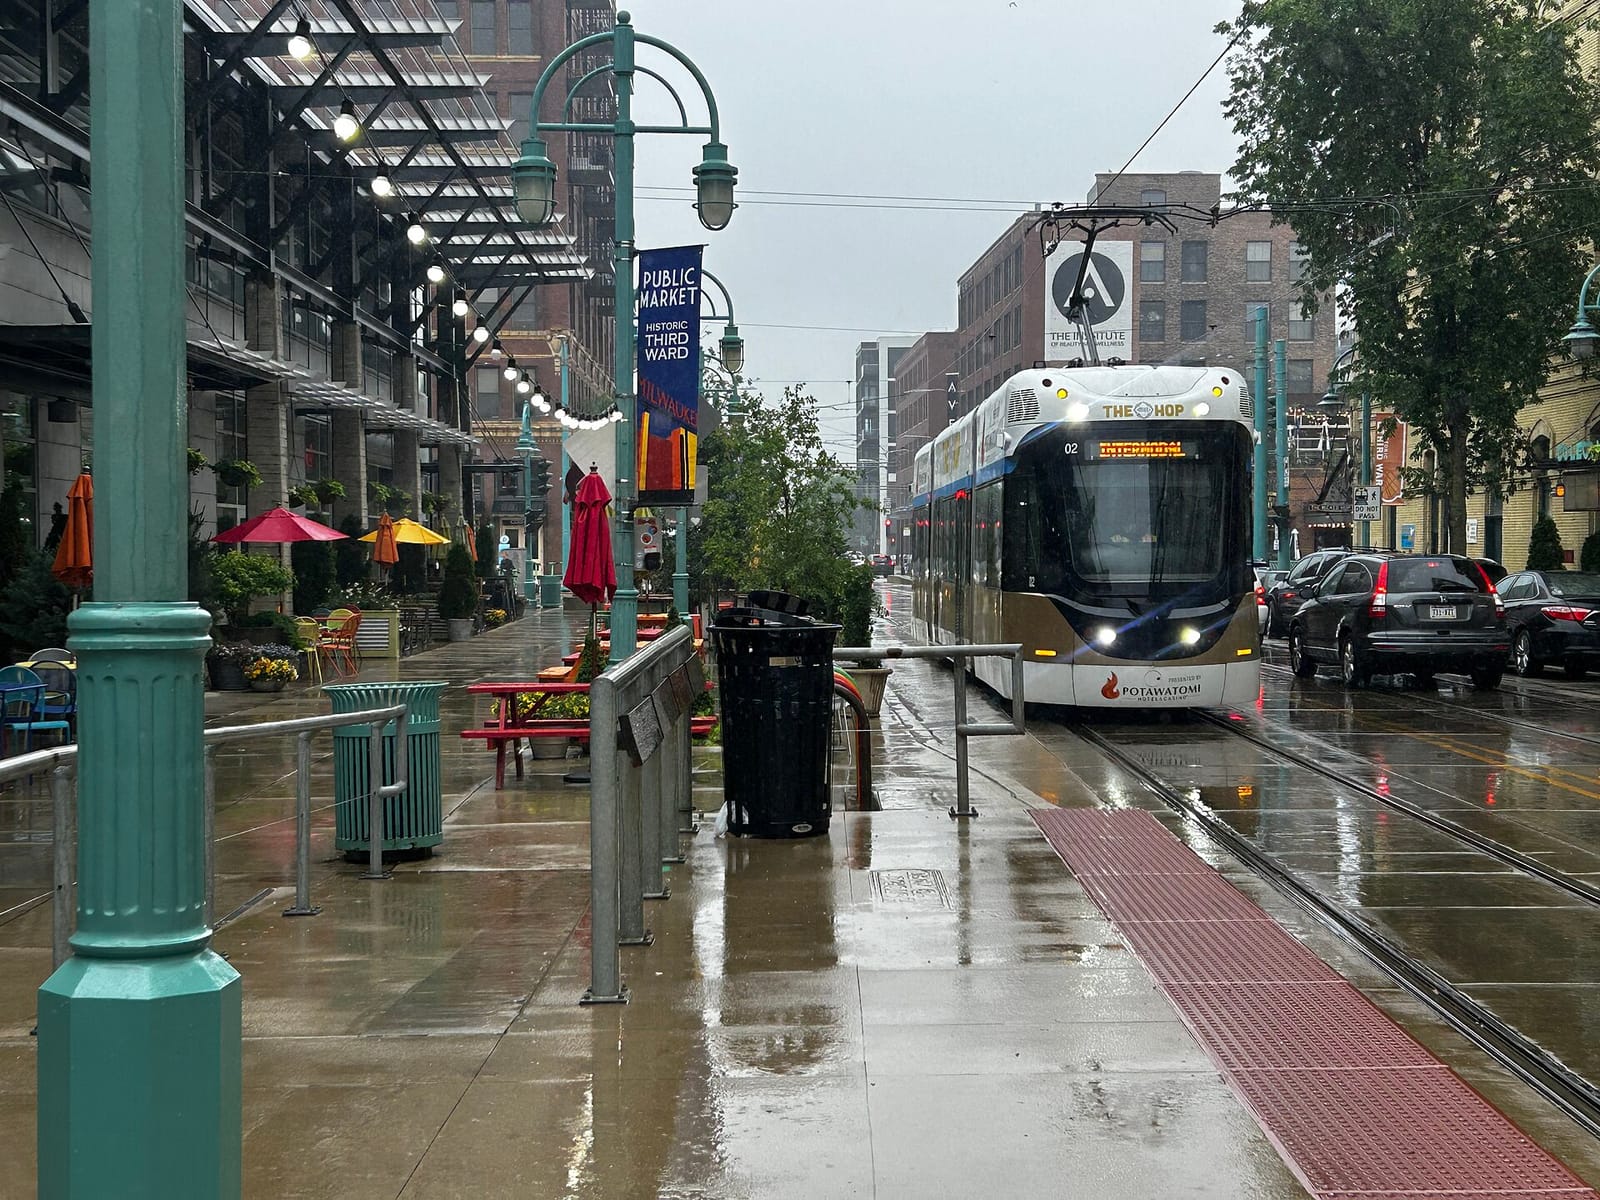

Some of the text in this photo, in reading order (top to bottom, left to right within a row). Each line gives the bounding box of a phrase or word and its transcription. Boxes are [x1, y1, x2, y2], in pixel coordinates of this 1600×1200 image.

[643, 267, 696, 289] PUBLIC
[640, 286, 699, 309] MARKET
[646, 320, 688, 332] HISTORIC
[645, 332, 689, 347] THIRD
[1051, 332, 1071, 341] THE
[645, 346, 689, 361] WARD
[1102, 404, 1134, 418] THE
[1154, 403, 1185, 417] HOP
[1064, 442, 1079, 454] 02
[1375, 463, 1385, 487] WAR
[1355, 505, 1365, 513] DO
[1122, 683, 1201, 697] POTAWATOMI
